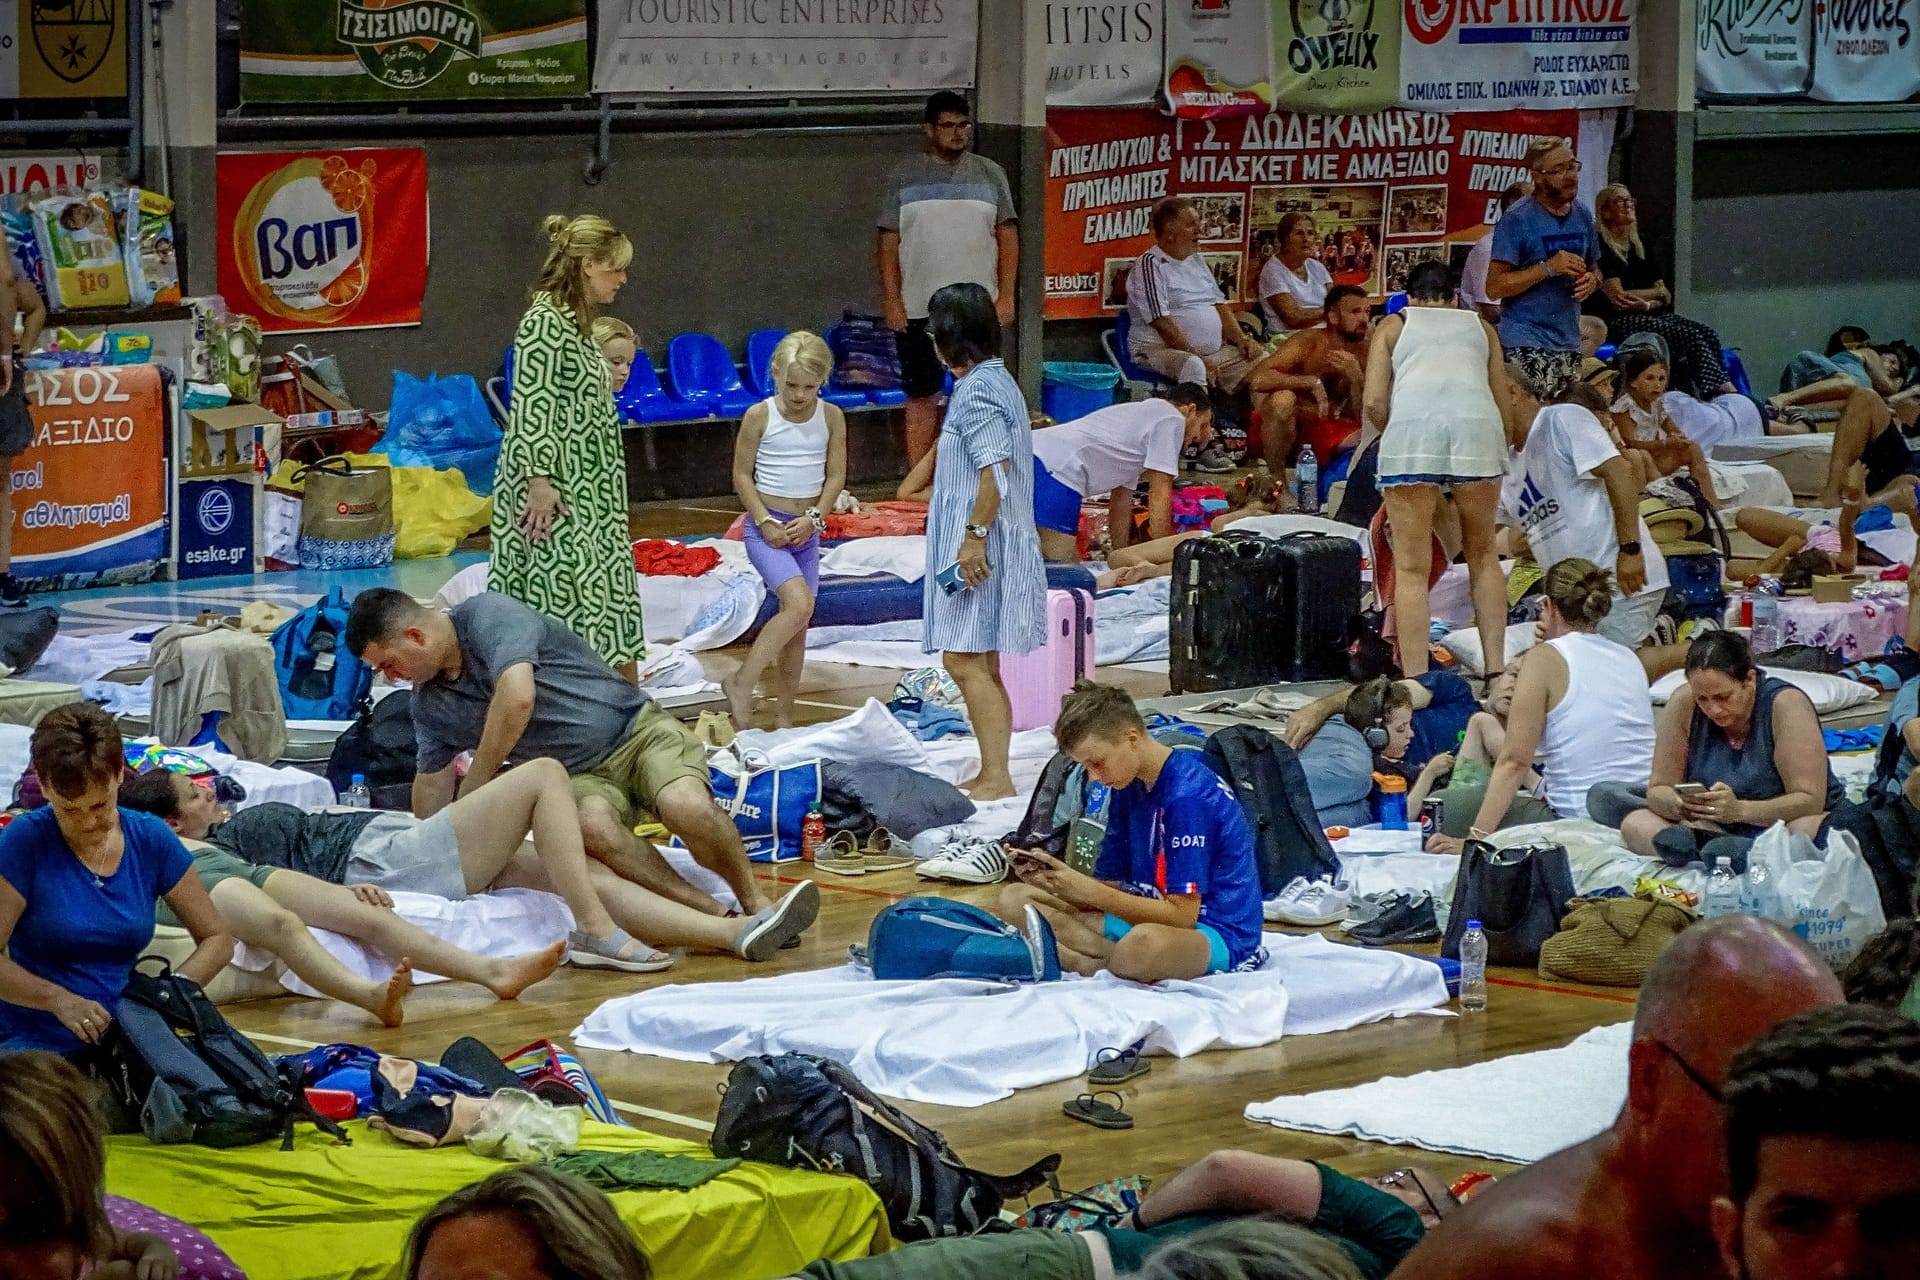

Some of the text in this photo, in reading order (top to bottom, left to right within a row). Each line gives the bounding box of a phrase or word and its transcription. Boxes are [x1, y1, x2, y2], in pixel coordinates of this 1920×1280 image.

[342, 6, 475, 46] ΤΣΙΣΙΜΟΙΡΗ
[780, 0, 945, 24] ENTERPRISES
[1288, 31, 1380, 73] OVELIX
[1533, 55, 1565, 73] ΡΟΔΟΣ
[480, 74, 506, 86] Super
[1048, 64, 1130, 81] HOTELS
[1407, 82, 1453, 100] ΟΜΙΛΟΣ
[1457, 81, 1488, 99] ΕΠΙΧ.
[1493, 80, 1540, 98] ΙΩΑΝΝΗ
[1240, 113, 1455, 150] ΔΩΔΕΚΑΝΗΣΟΣ
[1049, 133, 1172, 178] ΚΥΠΕΛΛΟΥΧΟΙ &
[1180, 149, 1449, 185] ΜΠΑΣΚΕΤ ΜΕ ΑΜΑΞΙΔΙΟ
[1062, 168, 1168, 211] ΠΡΩΤΑΘΛΗΤΕΣ
[1083, 206, 1153, 244] ΕΛΛΑΔΟΣ
[30, 416, 134, 448] ΑΞΙΔΙΟ
[23, 494, 131, 530] αθλητισμό!
[185, 545, 247, 565] esake.gr
[1171, 835, 1206, 849] GOAT
